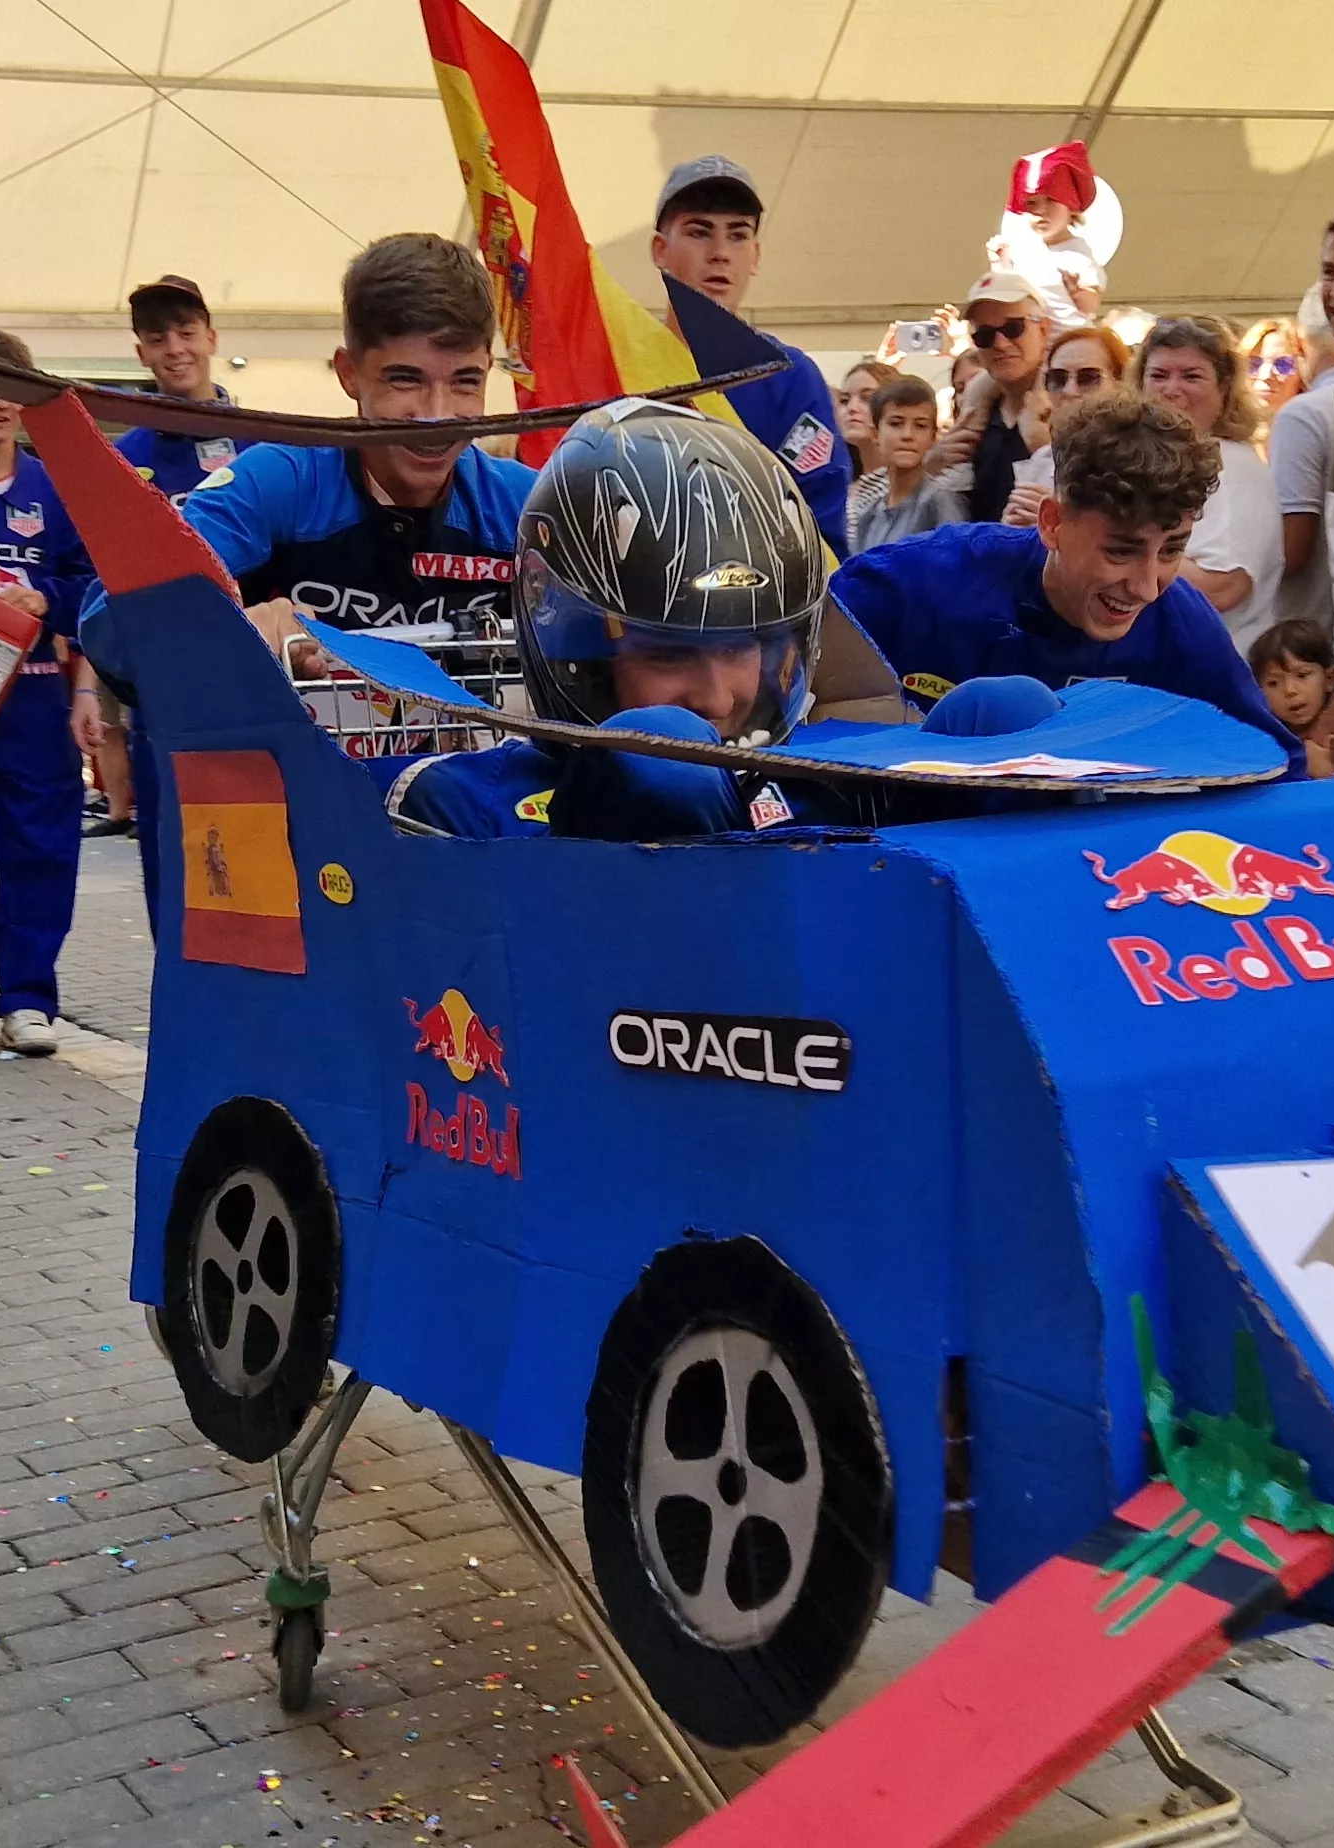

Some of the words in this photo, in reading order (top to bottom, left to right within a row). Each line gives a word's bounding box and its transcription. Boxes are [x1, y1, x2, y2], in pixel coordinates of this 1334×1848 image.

[1107, 920, 1294, 1006] Red
[610, 1014, 846, 1091] ORACLE
[406, 1081, 467, 1161] Red
